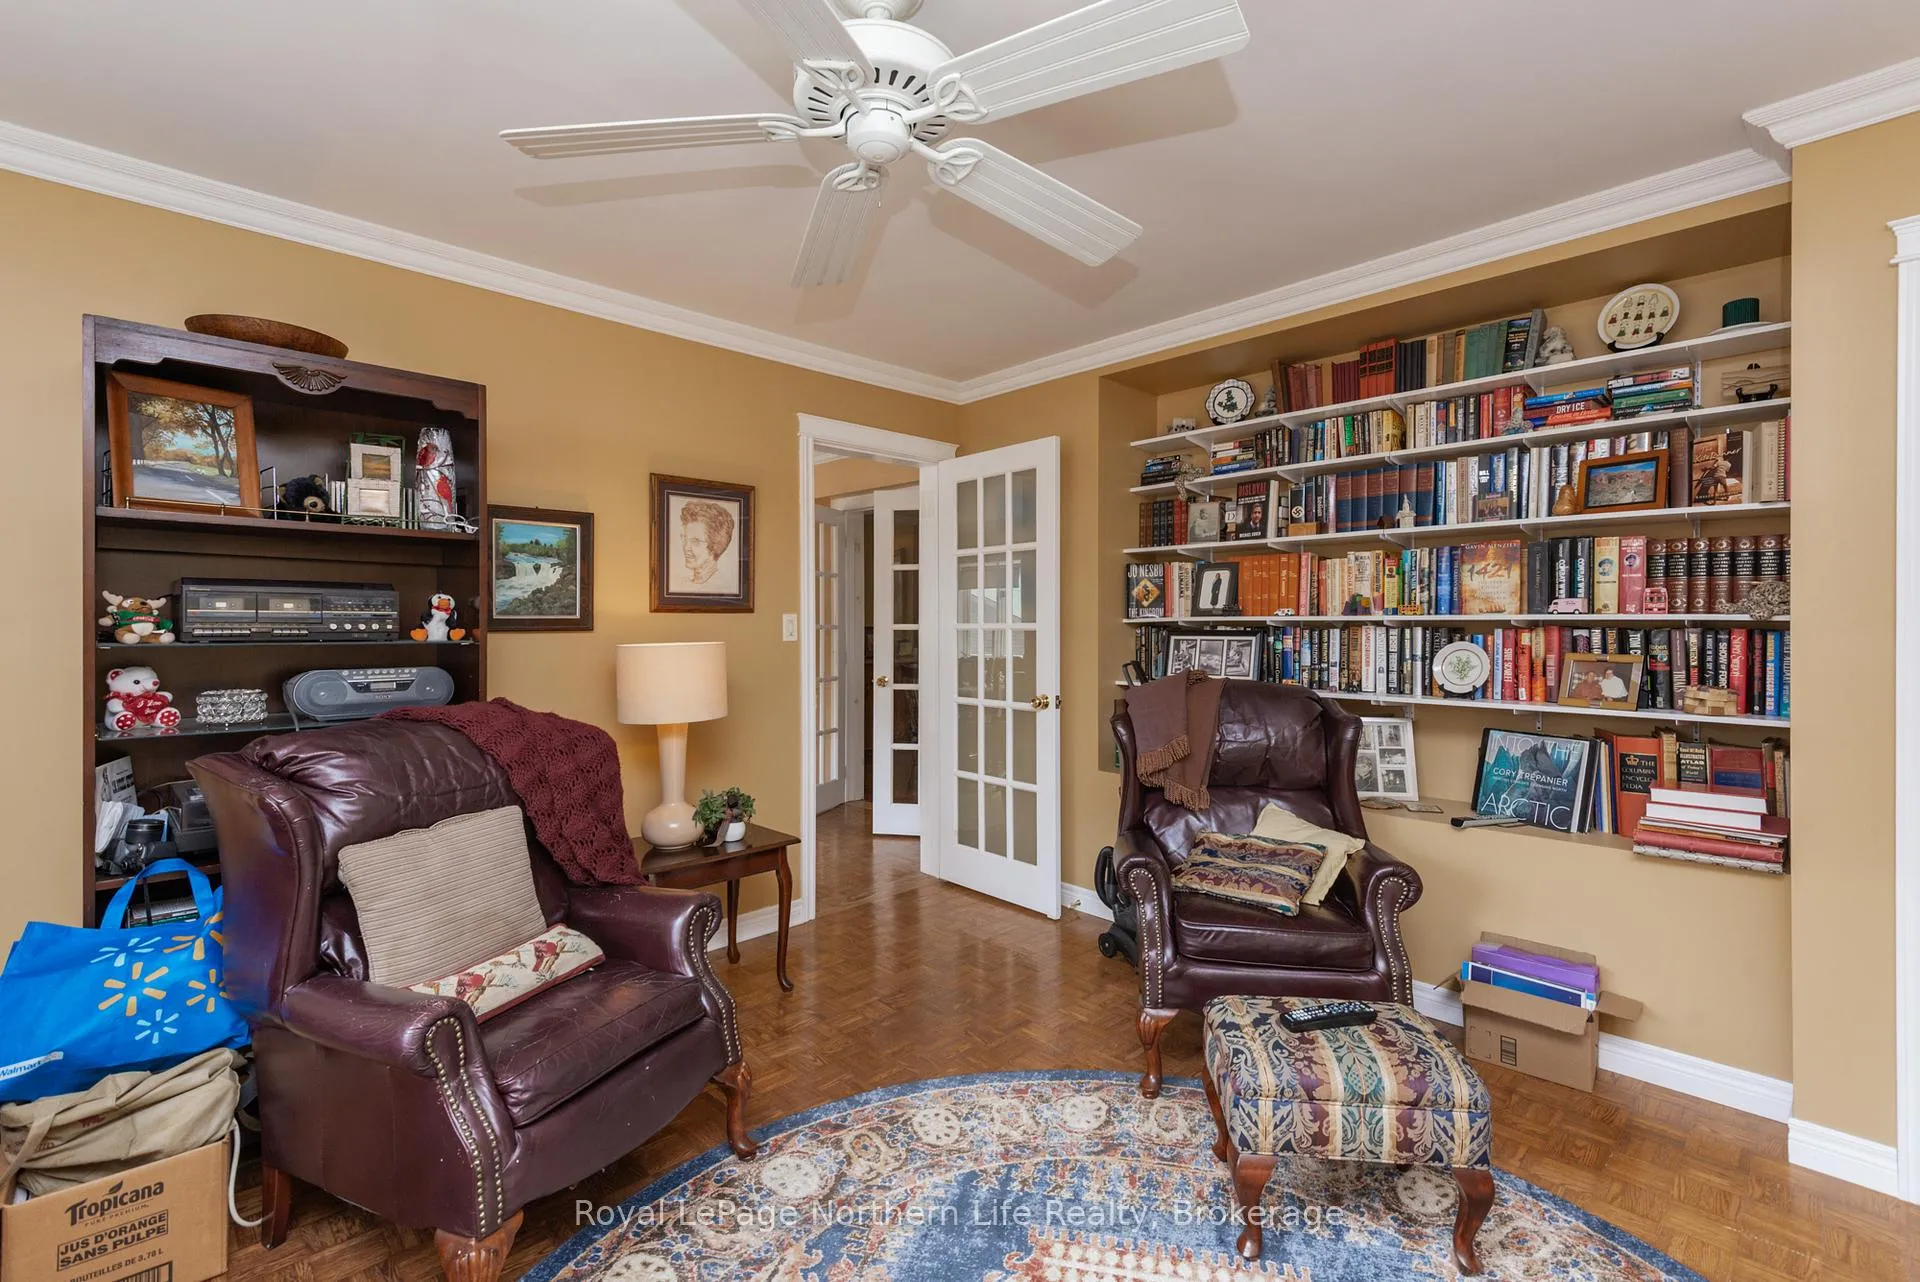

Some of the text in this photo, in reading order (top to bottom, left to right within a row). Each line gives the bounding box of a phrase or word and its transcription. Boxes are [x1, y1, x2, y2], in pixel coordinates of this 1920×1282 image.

[1556, 403, 1571, 414] DRY
[1572, 402, 1586, 412] ICE
[1127, 564, 1138, 578] JO
[1467, 562, 1513, 582] 1421
[1630, 633, 1640, 648] TOM
[1719, 642, 1727, 664] SHOW
[1504, 662, 1512, 682] SCARLET
[1674, 670, 1686, 693] TRIALS
[1719, 670, 1727, 689] FORC
[1766, 663, 1775, 697] PERISCOPE
[1493, 766, 1517, 777] CORY
[1480, 792, 1571, 830] ARCTIC
[0, 1058, 43, 1078] Walmart
[64, 1181, 165, 1228] Tropicana
[60, 1212, 167, 1255] JUS D'ORANGE
[60, 1223, 167, 1268] SANS PULPE
[124, 1256, 137, 1267] DE
